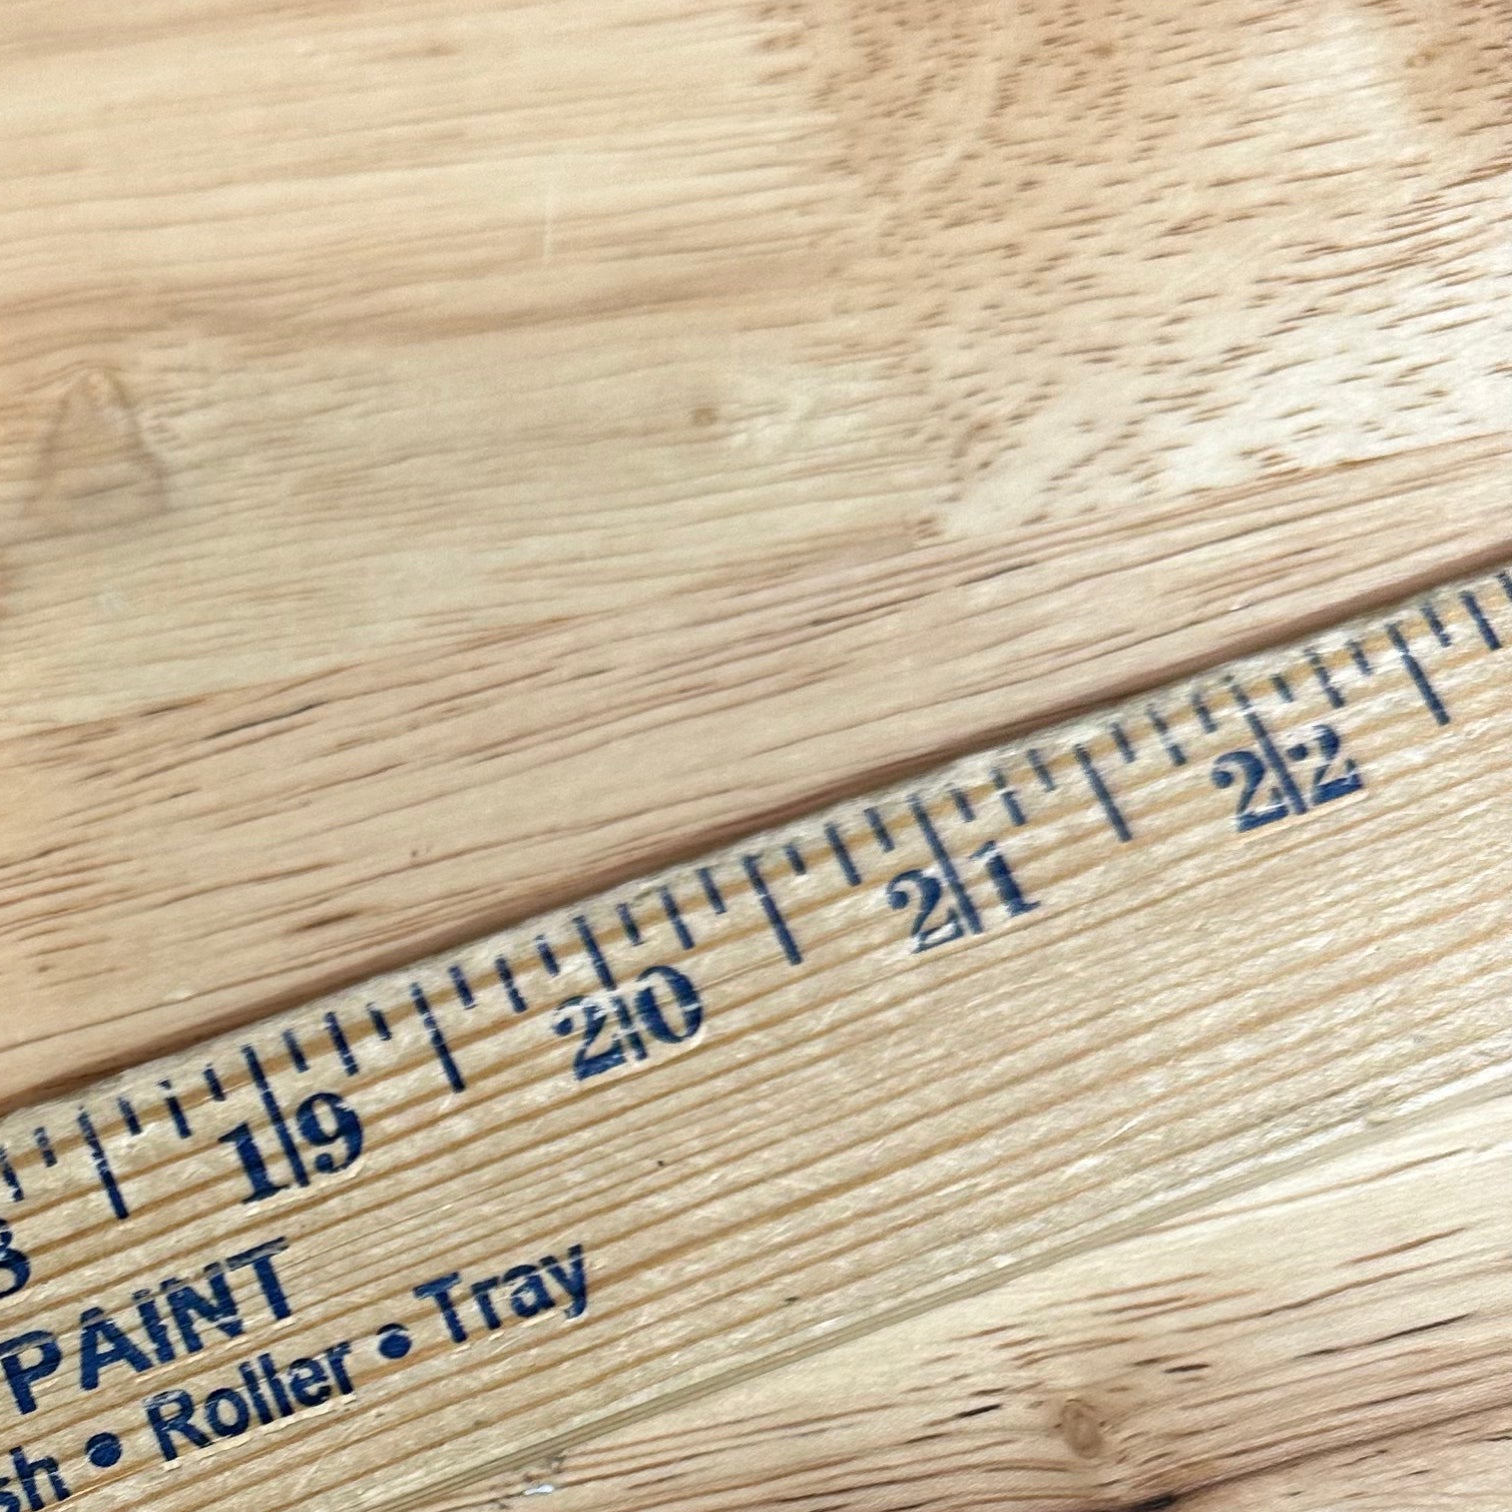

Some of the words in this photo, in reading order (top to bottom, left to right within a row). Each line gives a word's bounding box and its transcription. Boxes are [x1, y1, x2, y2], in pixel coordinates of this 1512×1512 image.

[219, 1092, 364, 1205] 19
[552, 965, 704, 1081] 20
[889, 841, 1040, 953] 21
[1211, 724, 1364, 833] 22
[147, 1341, 356, 1461] Roller
[415, 1244, 589, 1343] Tray
